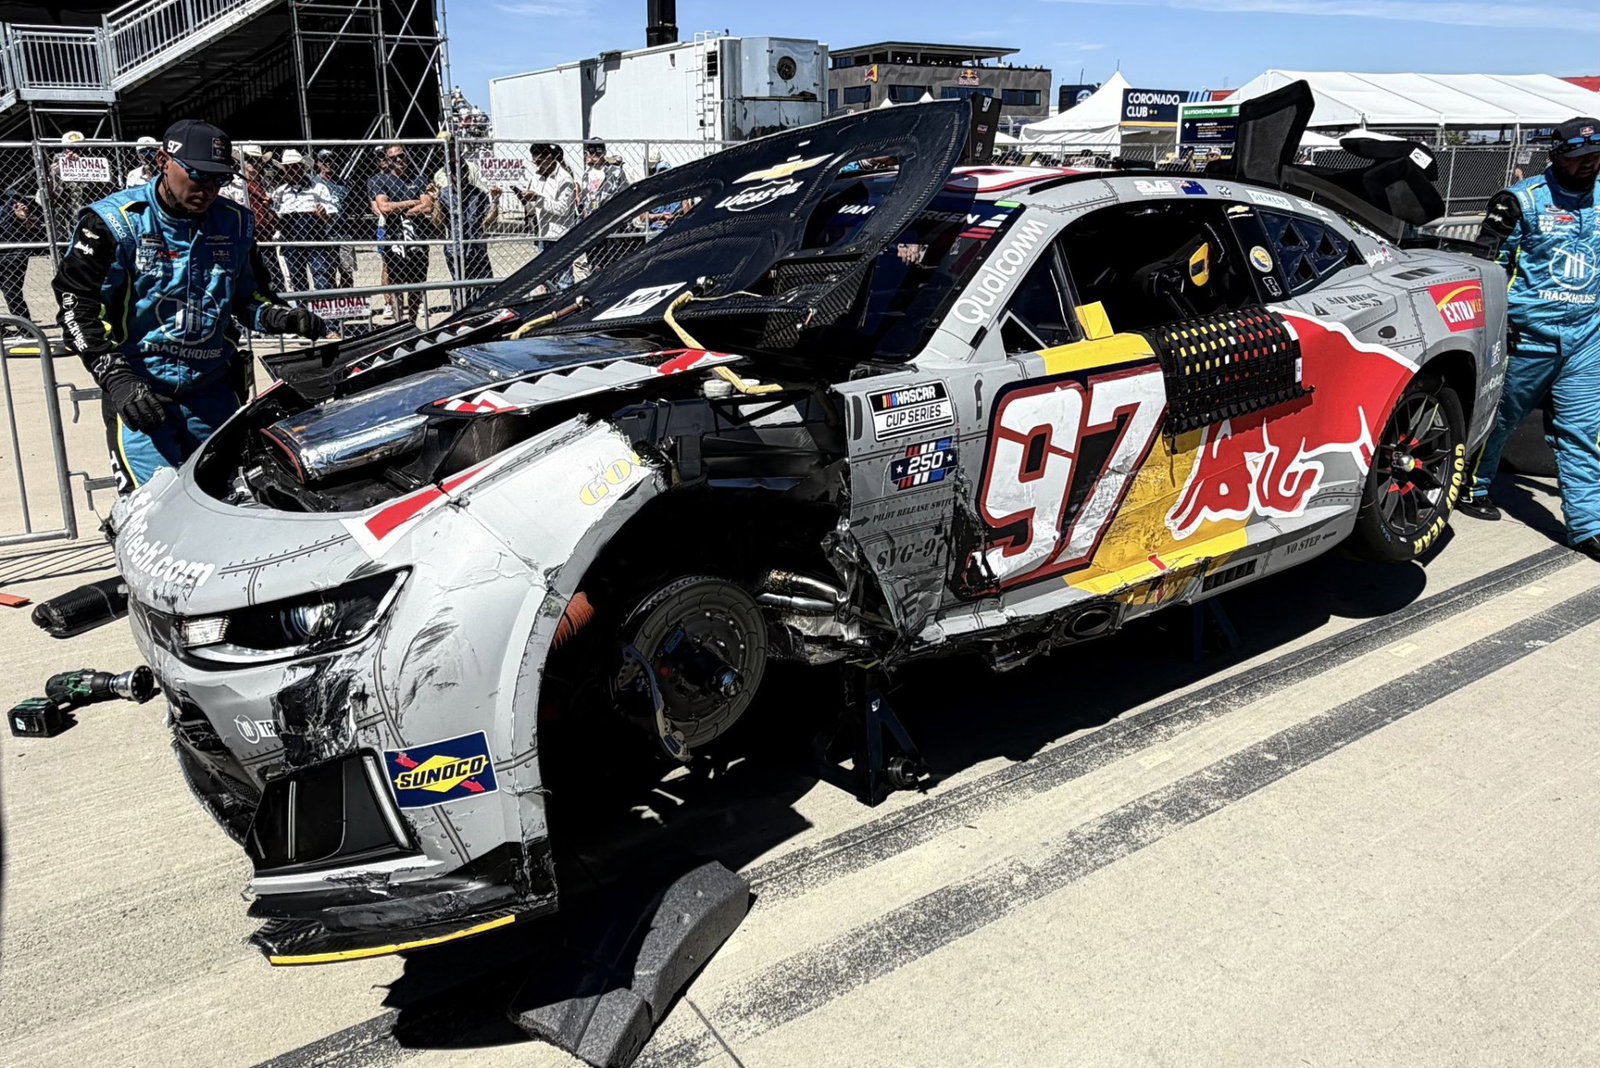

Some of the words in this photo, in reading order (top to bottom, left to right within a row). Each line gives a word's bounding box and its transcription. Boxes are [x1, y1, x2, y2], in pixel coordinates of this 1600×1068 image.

[1128, 92, 1180, 105] CORONADO
[1126, 106, 1149, 118] CLUB
[167, 140, 183, 153] 97
[61, 158, 106, 170] NATIONAL
[480, 159, 526, 170] NATIONAL
[838, 204, 875, 215] VAN
[951, 218, 1049, 324] Qualcomm
[311, 296, 370, 310] NATIONAL
[141, 340, 223, 360] TRACKHOUSE
[896, 385, 937, 407] NASCAR
[885, 411, 907, 428] CUP
[907, 404, 942, 424] SERIES
[906, 450, 945, 475] 250
[963, 363, 1168, 595] 97
[872, 508, 897, 523] PILOT
[896, 500, 931, 518] RELEASE
[1283, 542, 1299, 557] NO
[1297, 534, 1322, 552] STEP
[399, 756, 486, 789] SUNOCO
